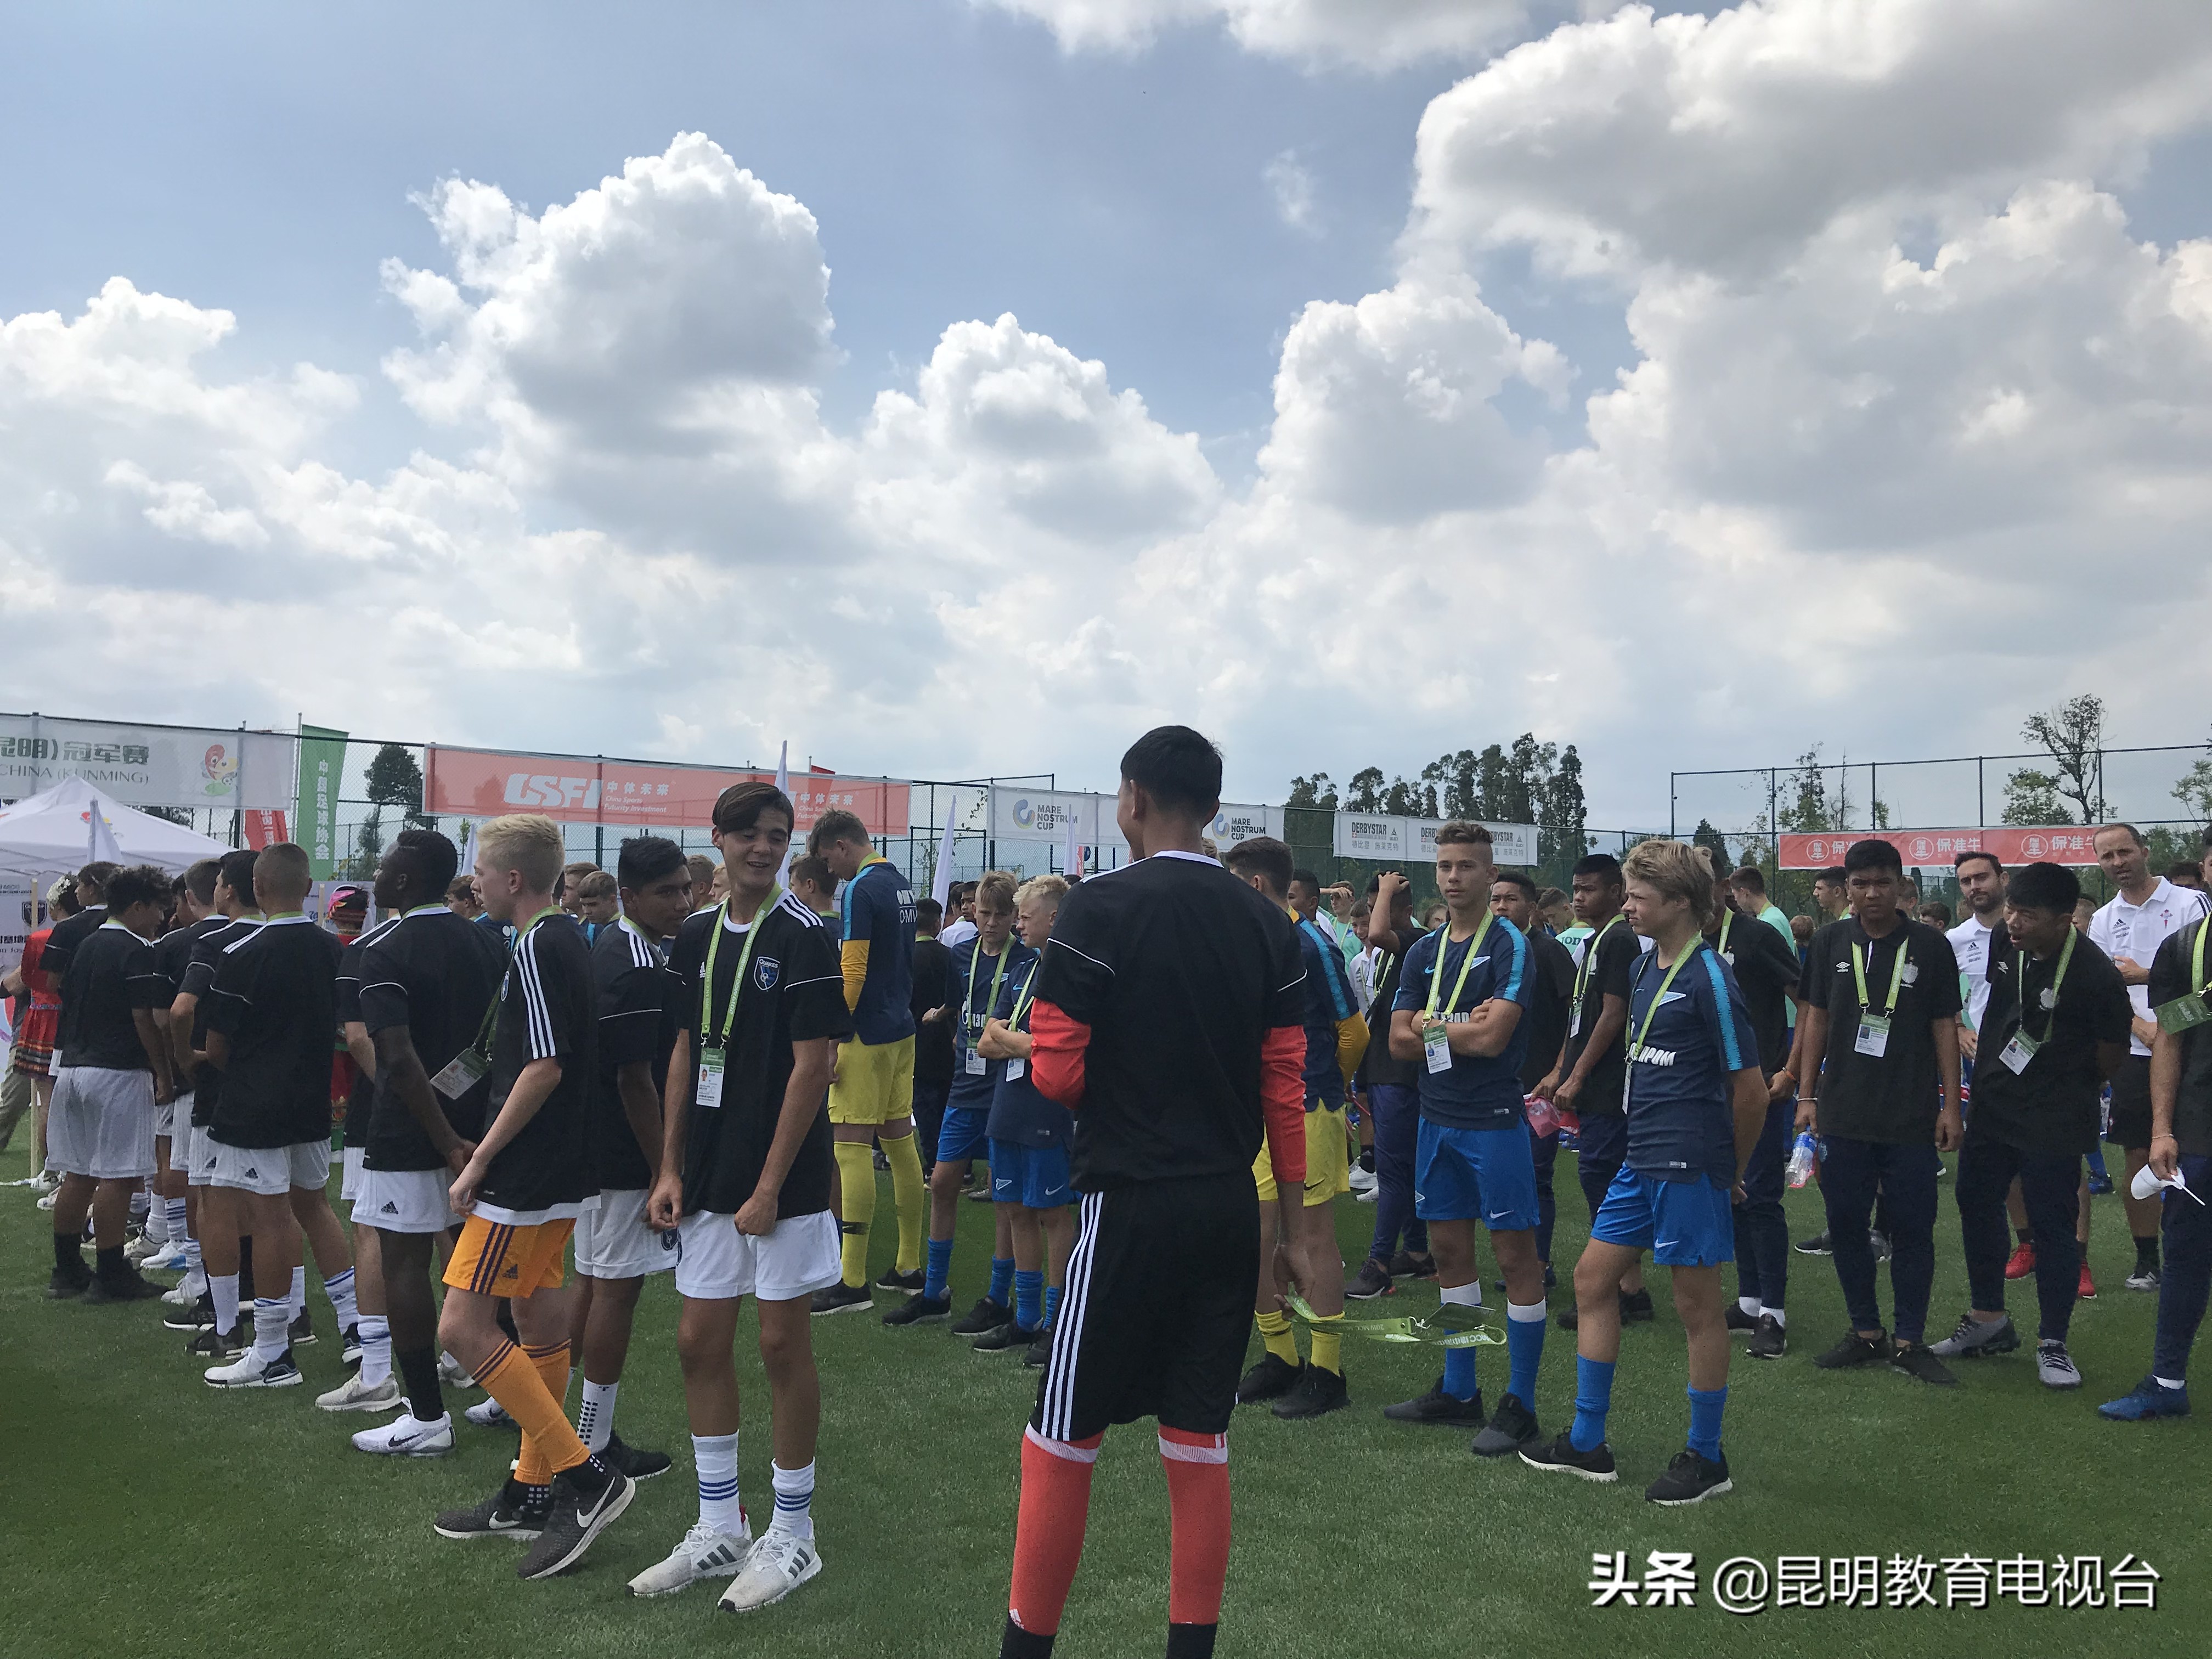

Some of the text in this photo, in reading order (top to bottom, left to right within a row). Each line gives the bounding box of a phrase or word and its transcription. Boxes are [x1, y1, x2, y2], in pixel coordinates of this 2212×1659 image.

[607, 781, 669, 795] 中体未来
[1037, 804, 1062, 814] MARE
[1036, 822, 1054, 831] CUP
[1231, 817, 1251, 826] MARE
[1231, 826, 1266, 834] NOSTRUM
[1352, 822, 1387, 835] DERBYSTAR
[1936, 837, 1982, 853] 保准牛
